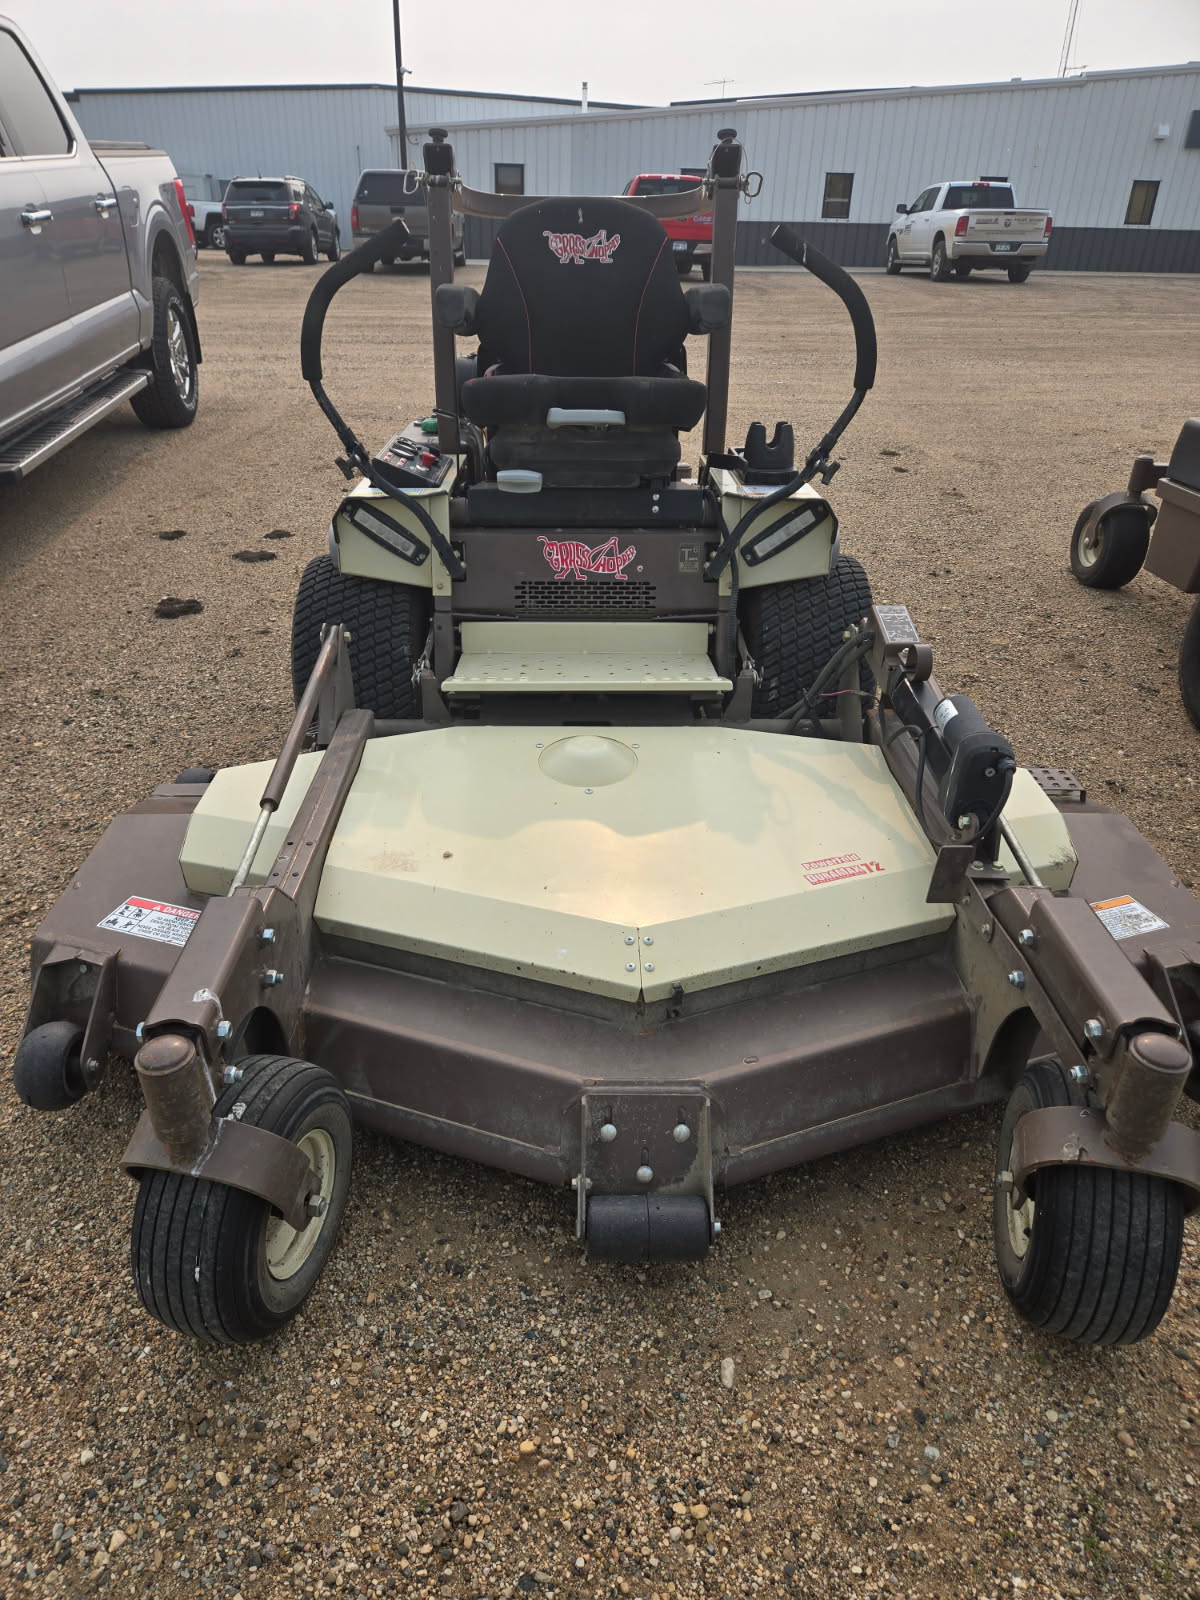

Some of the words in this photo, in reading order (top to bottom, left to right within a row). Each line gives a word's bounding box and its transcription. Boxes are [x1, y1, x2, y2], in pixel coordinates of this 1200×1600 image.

[540, 537, 637, 578] GRASSHOPPER
[861, 862, 886, 873] 72
[163, 907, 200, 920] DANGER
